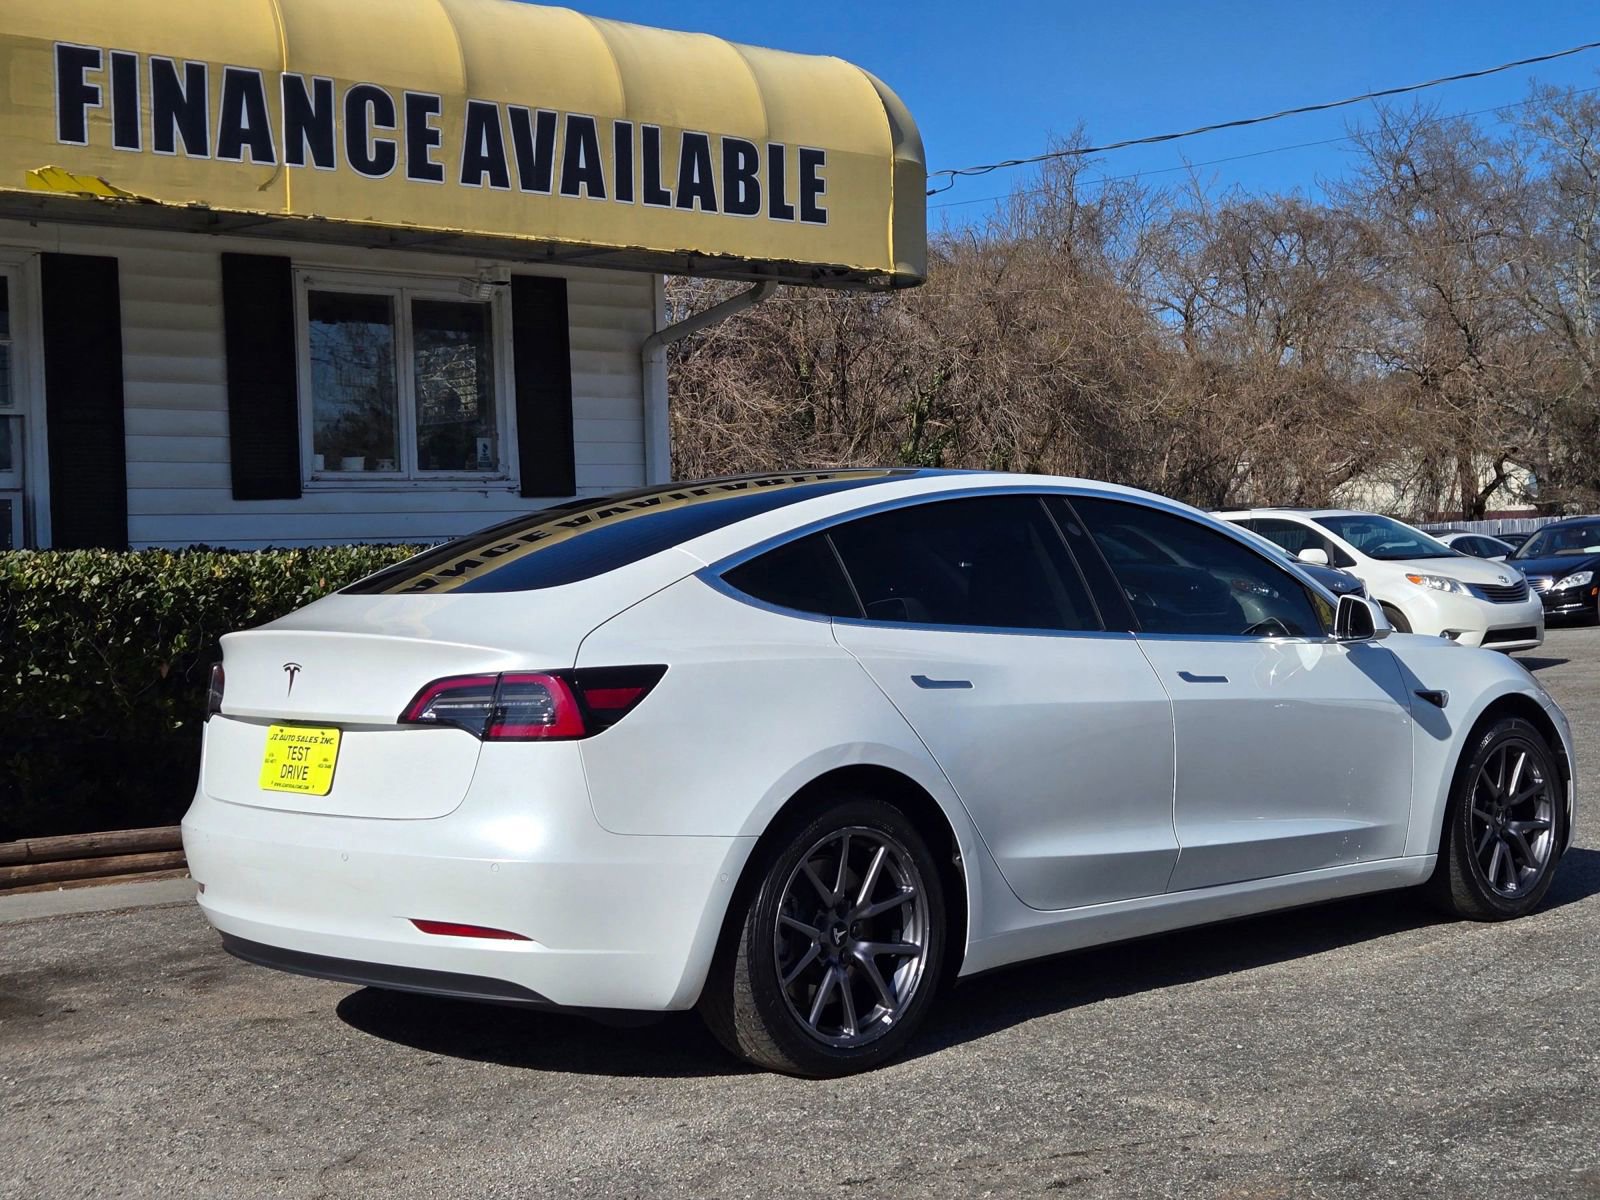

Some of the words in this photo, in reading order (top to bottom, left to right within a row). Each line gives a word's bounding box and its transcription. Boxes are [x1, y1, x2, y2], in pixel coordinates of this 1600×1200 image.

[54, 42, 446, 184] FINANCE
[459, 99, 828, 225] AVAILABLE
[279, 734, 296, 742] AUTO
[296, 735, 319, 744] SALES
[287, 745, 311, 762] TEST
[280, 763, 309, 781] DRIVE
